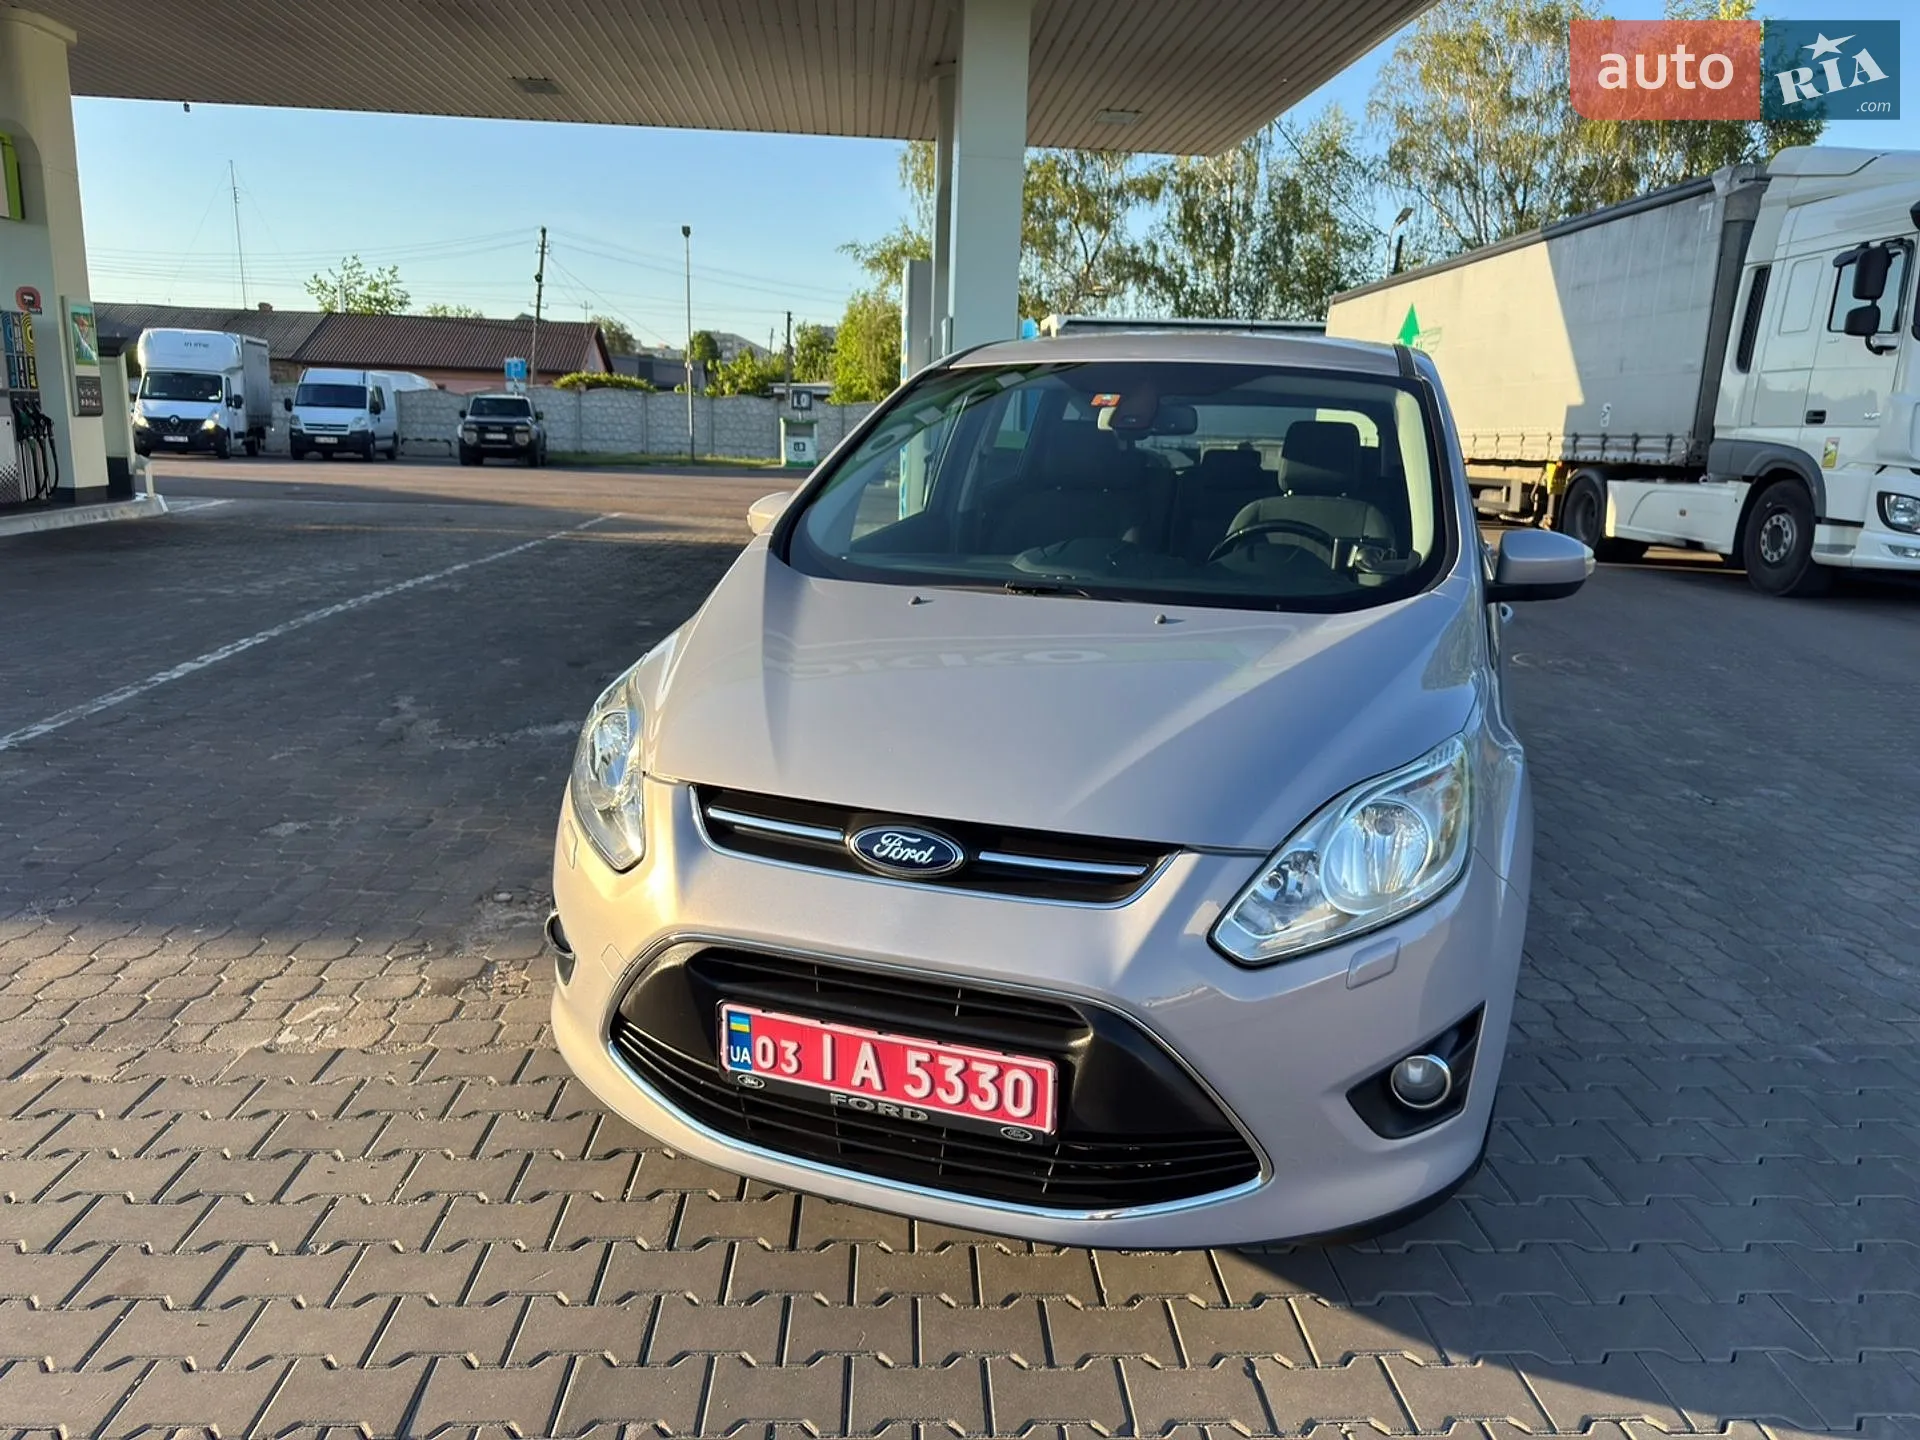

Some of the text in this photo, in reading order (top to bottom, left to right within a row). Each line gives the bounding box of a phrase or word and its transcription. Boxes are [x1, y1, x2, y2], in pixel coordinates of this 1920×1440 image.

[872, 832, 936, 865] Ford
[730, 1045, 752, 1065] UA
[755, 1035, 799, 1075] 03
[903, 1050, 1034, 1118] 5330
[830, 1092, 929, 1121] FORD
